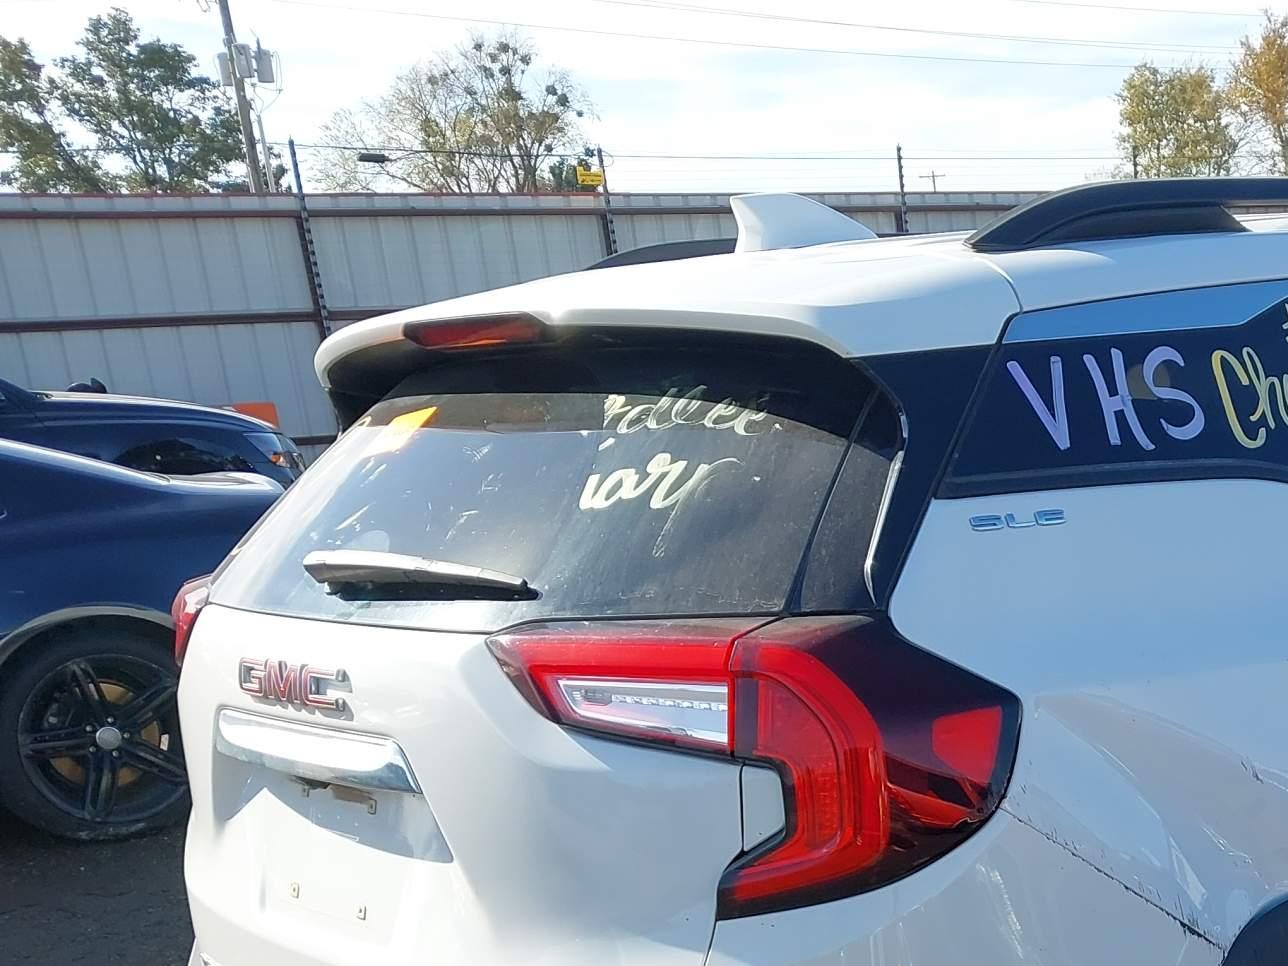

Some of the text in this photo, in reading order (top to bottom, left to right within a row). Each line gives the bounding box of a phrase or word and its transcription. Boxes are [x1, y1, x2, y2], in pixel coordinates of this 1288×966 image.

[1006, 345, 1205, 451] VHS
[968, 508, 1066, 532] SLE
[239, 657, 349, 712] GMC
